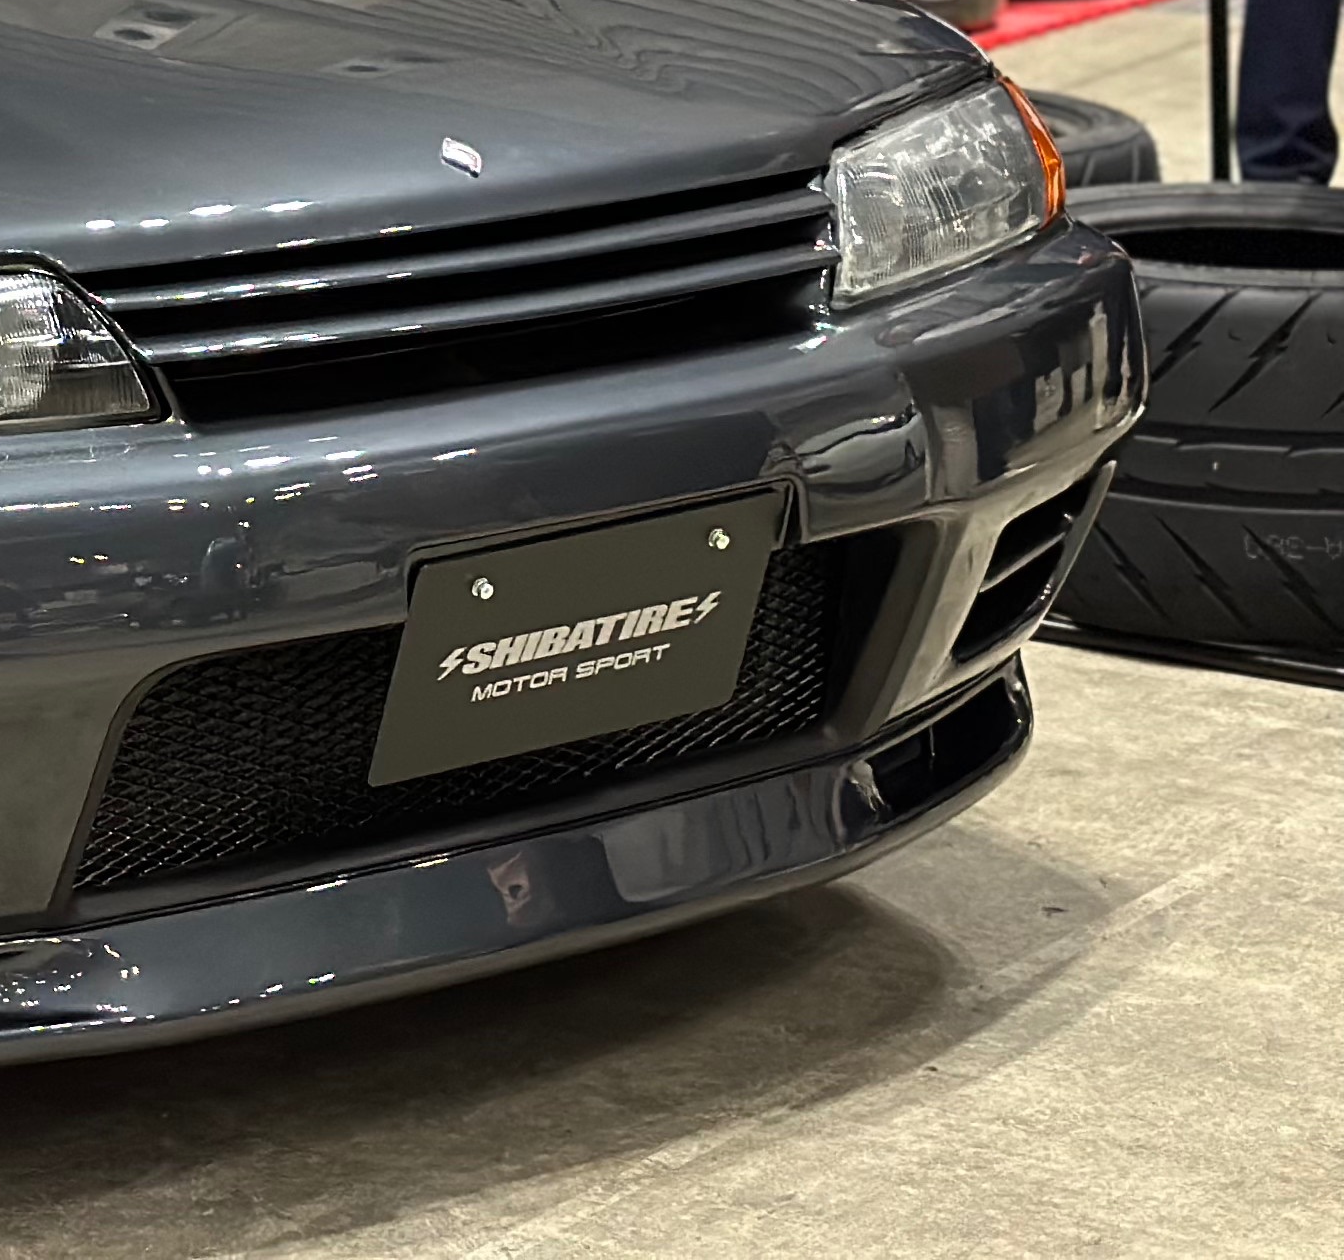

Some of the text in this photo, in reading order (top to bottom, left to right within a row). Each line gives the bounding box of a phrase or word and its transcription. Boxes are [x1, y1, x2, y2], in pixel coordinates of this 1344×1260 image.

[461, 596, 699, 676] SHIBATIRE
[470, 643, 671, 703] MOTOR SPORT
